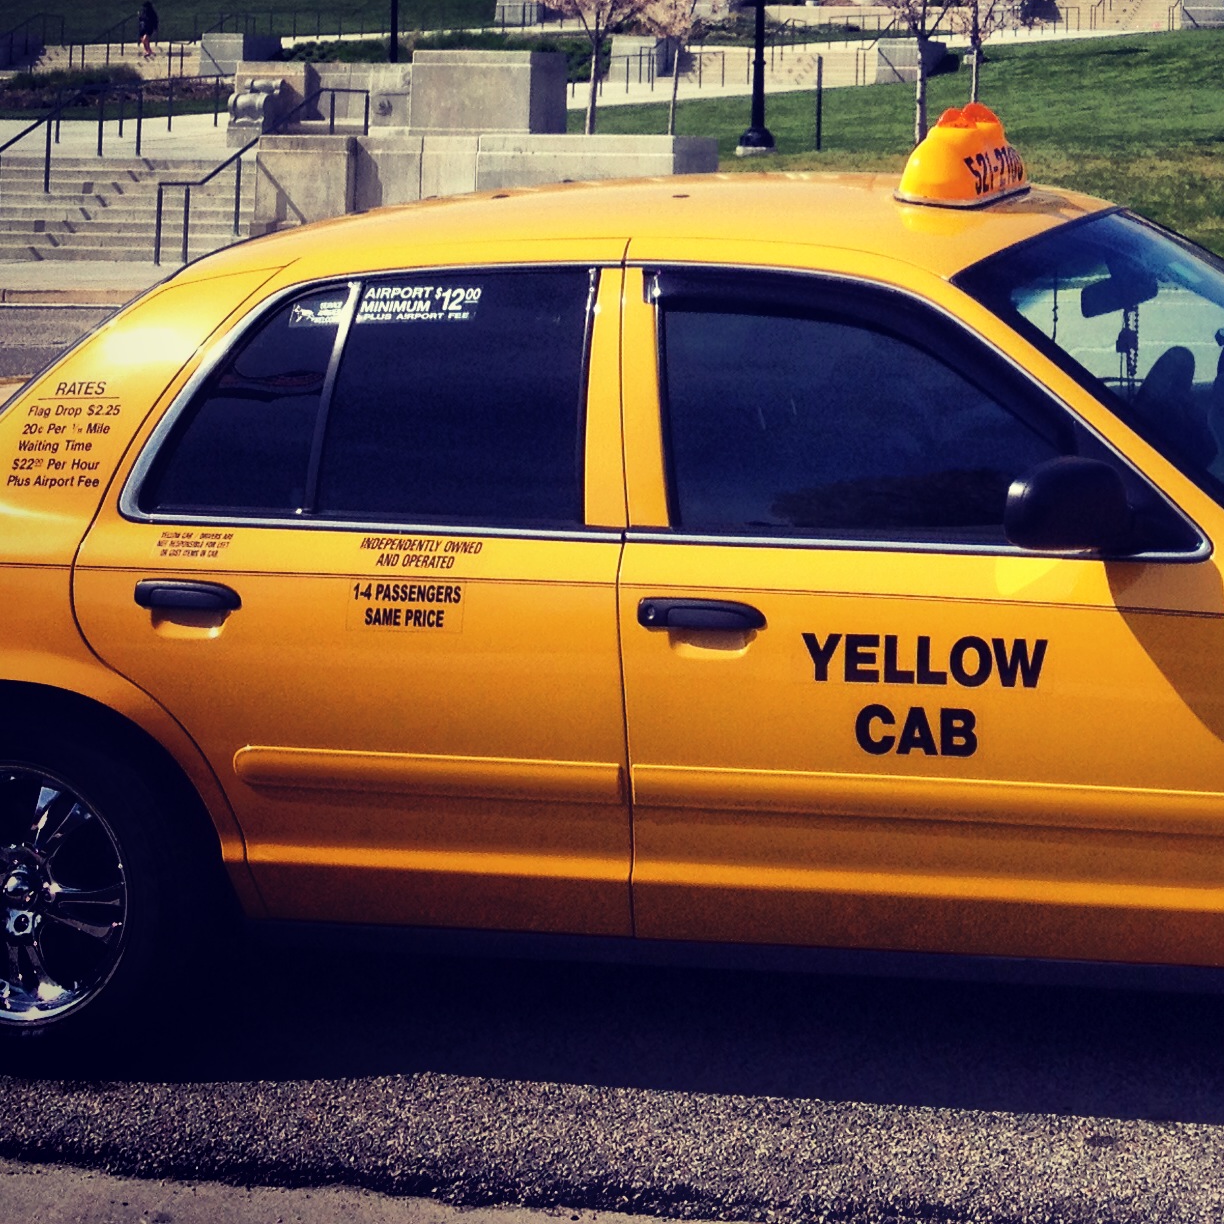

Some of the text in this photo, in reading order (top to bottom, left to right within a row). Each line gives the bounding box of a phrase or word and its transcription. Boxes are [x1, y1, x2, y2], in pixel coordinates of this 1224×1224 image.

[963, 146, 1023, 195] 521-2100
[365, 287, 433, 299] AIRPORT
[361, 301, 430, 312] MINIMUM
[396, 312, 444, 320] AIRPORT
[55, 382, 107, 395] RATES
[28, 404, 121, 418] Flag Drop $2.25
[47, 424, 67, 434] Per
[86, 423, 110, 434] Mile
[18, 440, 92, 453] Waiting Time
[47, 458, 67, 470] Per
[71, 458, 100, 470] Hour
[7, 475, 100, 488] Plus Airport Fee
[360, 537, 483, 554] INDEPENDENTLY OWNED
[376, 553, 455, 569] AND OPERATED
[353, 582, 462, 604] 1-4 PASSENGERS
[364, 607, 445, 628] SAME PRICE
[801, 632, 1049, 689] YELLOW
[854, 703, 979, 758] CAB
